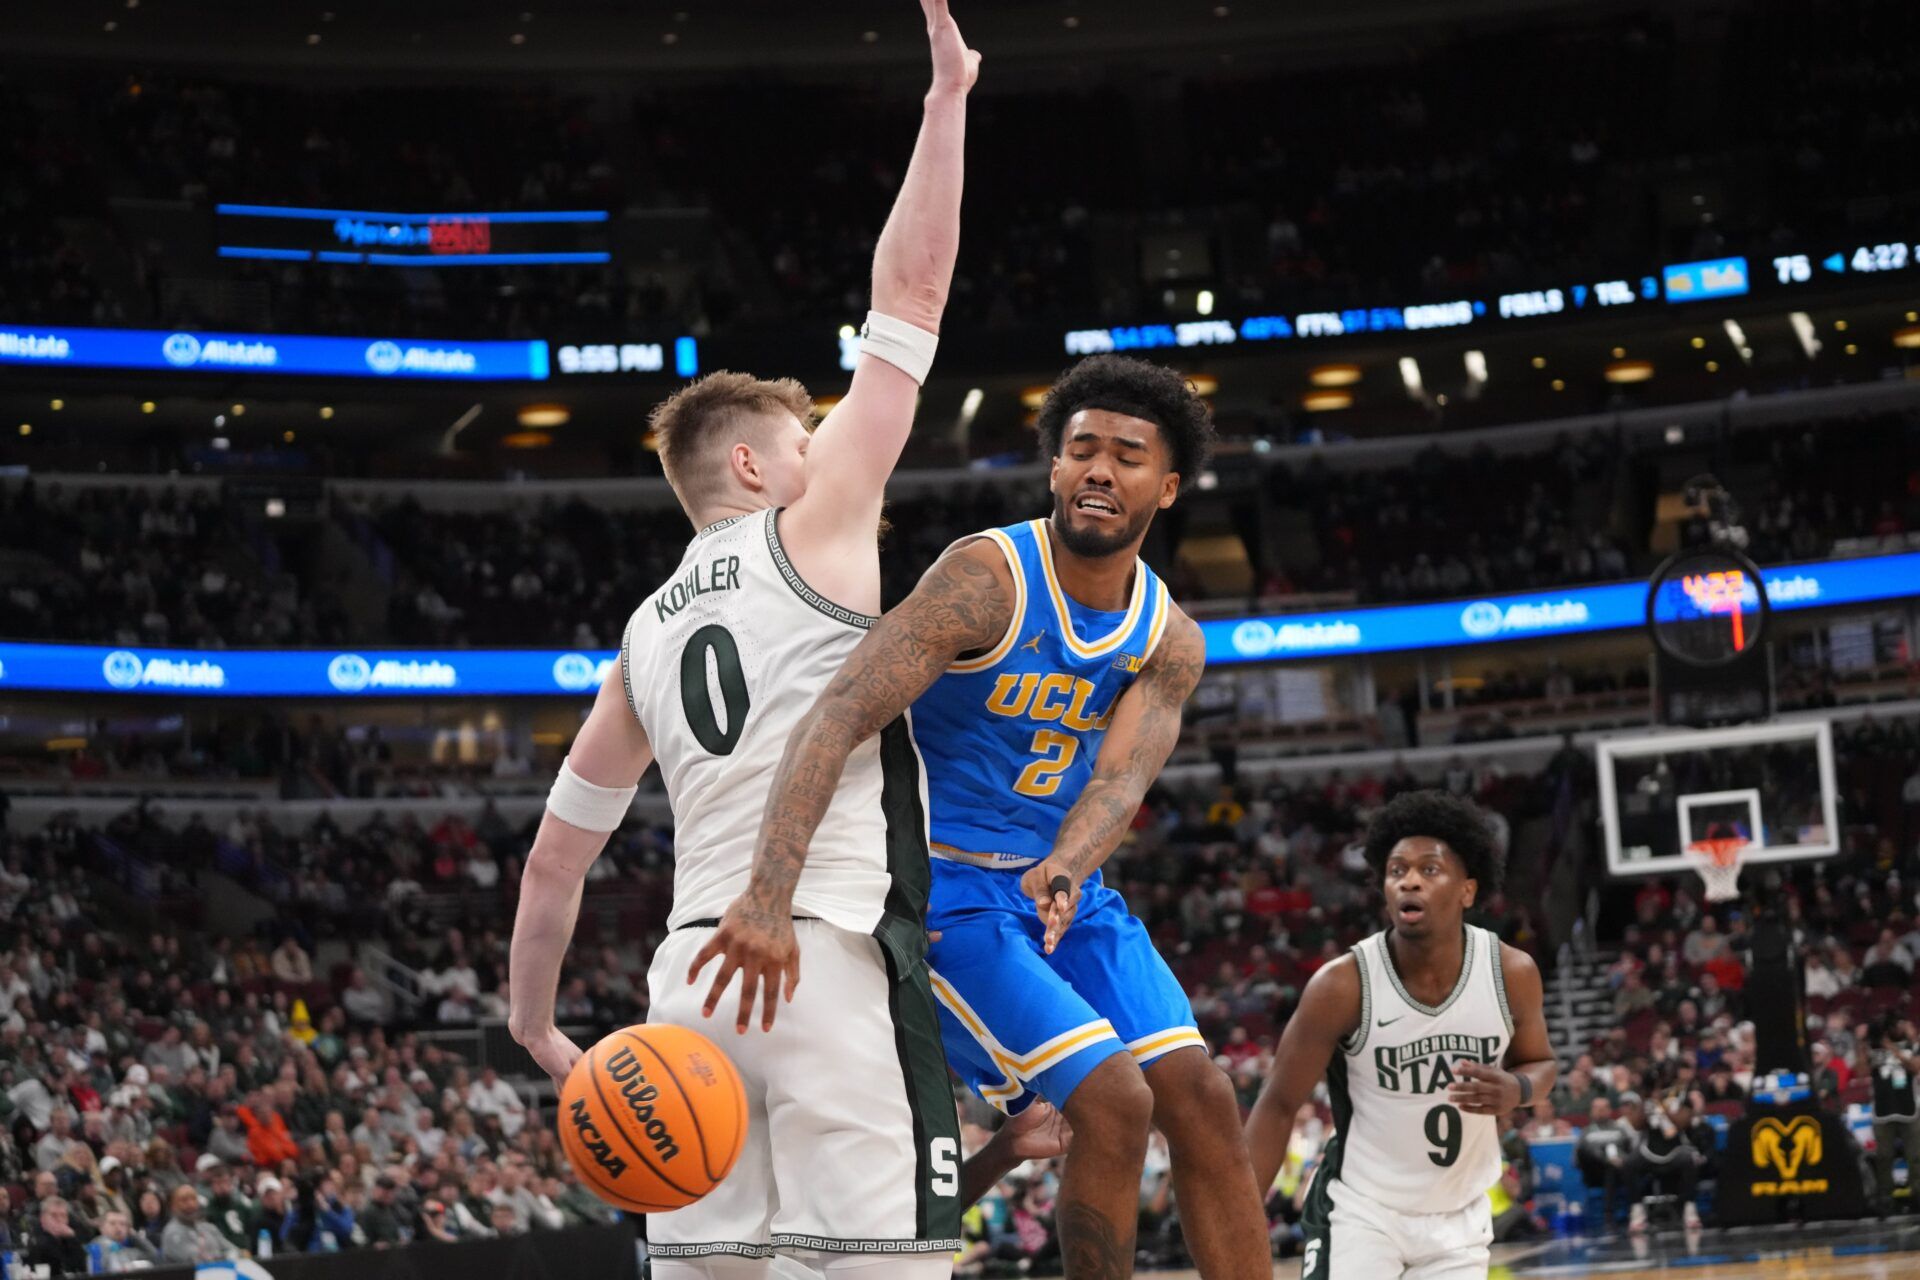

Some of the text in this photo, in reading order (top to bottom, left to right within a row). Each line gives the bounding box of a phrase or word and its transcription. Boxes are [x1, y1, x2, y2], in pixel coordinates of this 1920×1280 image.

[1851, 242, 1908, 272] 4:22
[202, 339, 277, 366] Allstate
[402, 347, 477, 372] Allstate
[620, 343, 663, 372] PM
[655, 555, 741, 624] KOHLER
[1503, 600, 1588, 631] Allstate
[1276, 620, 1361, 650] Allstate
[142, 659, 225, 688] Allstate
[369, 660, 457, 689] Allstate
[680, 624, 751, 756] 0
[1012, 729, 1079, 797] 2
[1400, 1034, 1480, 1061] MICHIGAN
[605, 1045, 681, 1164] Wilson
[570, 1097, 629, 1180] NCAA
[1423, 1104, 1463, 1168] 9
[930, 1136, 959, 1198] S
[1751, 1179, 1828, 1197] RAM
